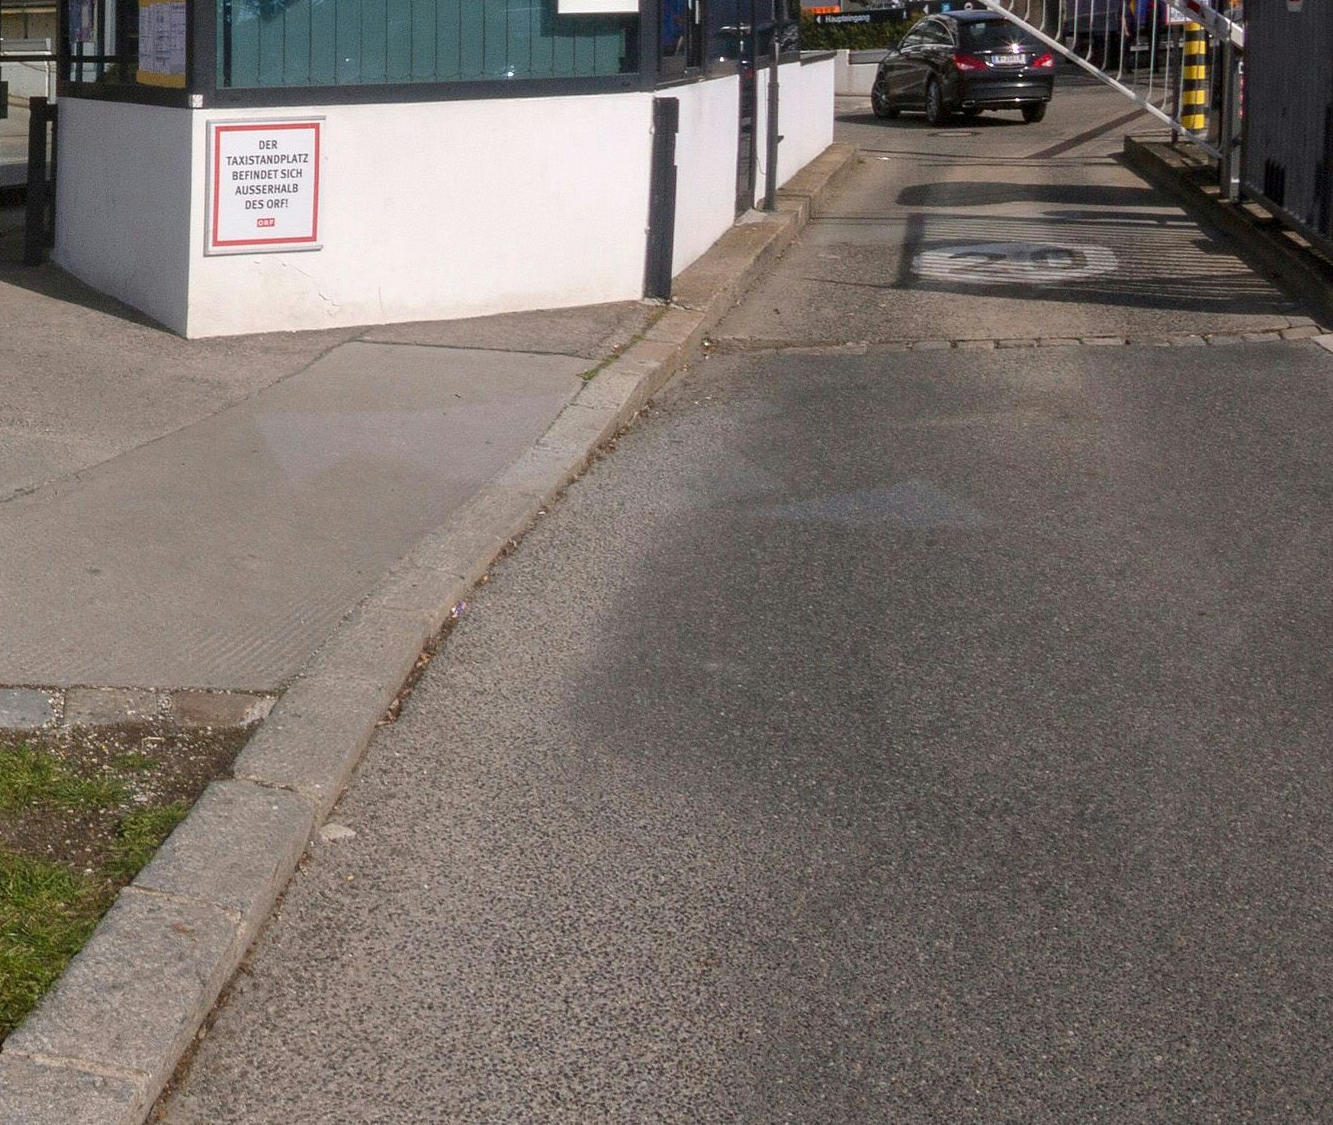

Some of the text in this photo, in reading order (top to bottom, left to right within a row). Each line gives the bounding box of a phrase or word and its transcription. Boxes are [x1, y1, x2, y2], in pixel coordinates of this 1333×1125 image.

[259, 139, 278, 150] DER
[226, 153, 309, 166] TAXISTANDPLATZ
[232, 168, 303, 181] BEFINDET SICH
[235, 183, 299, 195] AUSSERHALB
[245, 198, 289, 210] DES ORF!
[257, 219, 275, 227] ORF
